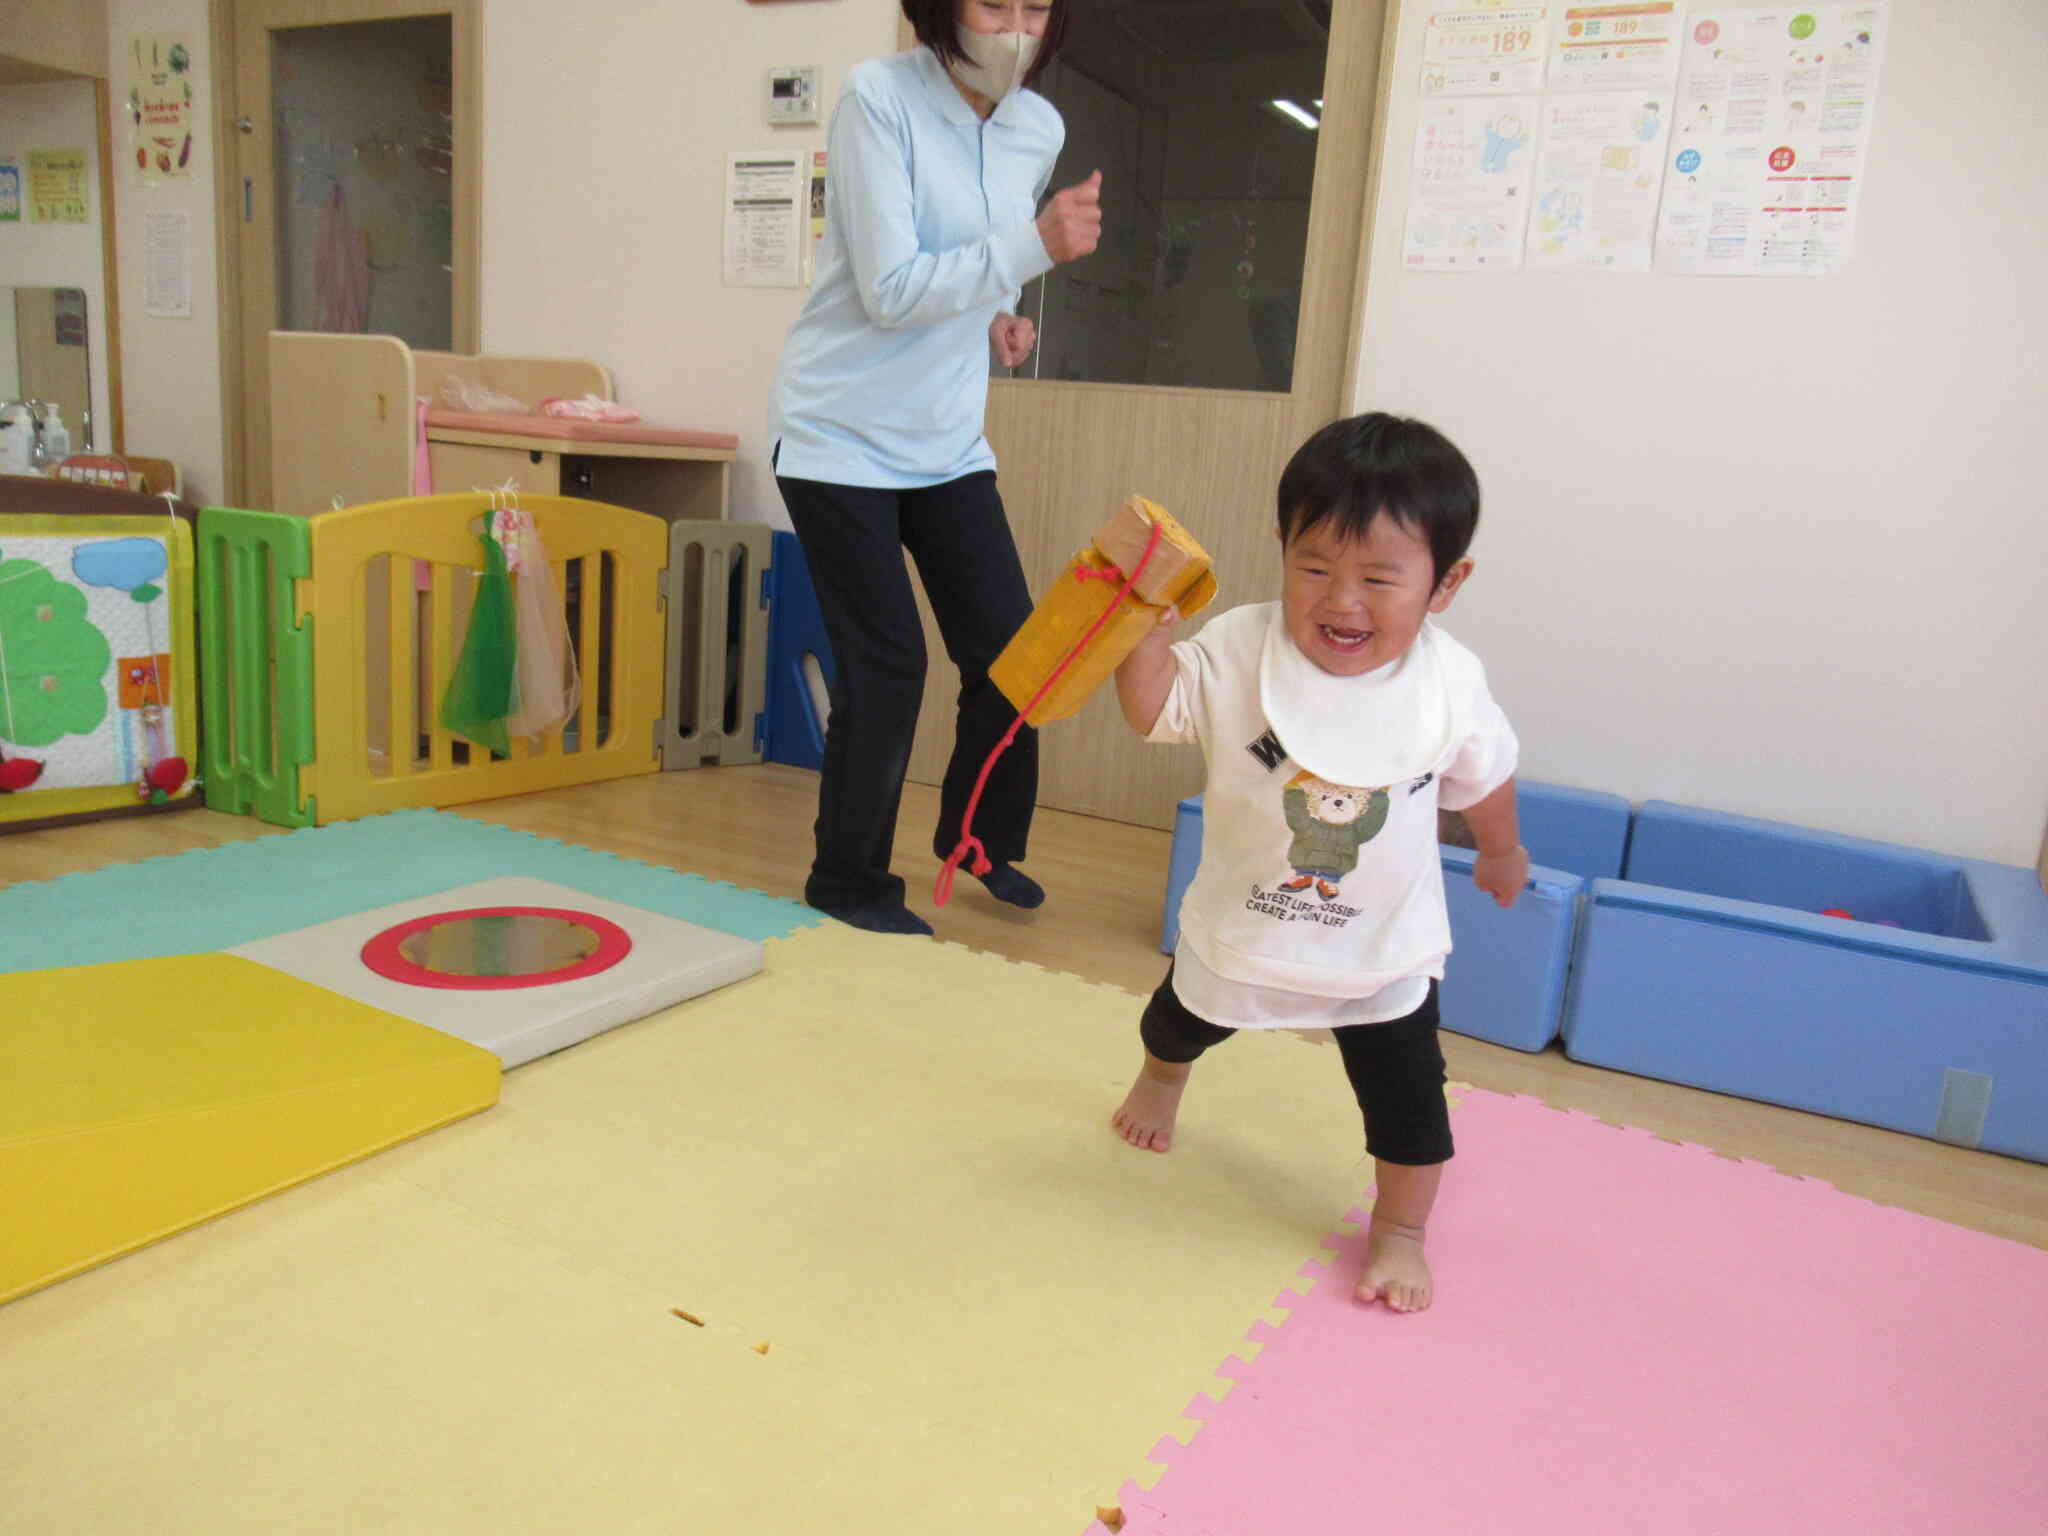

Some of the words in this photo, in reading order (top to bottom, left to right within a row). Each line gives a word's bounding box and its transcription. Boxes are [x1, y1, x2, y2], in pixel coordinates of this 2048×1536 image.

[1614, 20, 1638, 35] 189
[1492, 30, 1531, 53] 189
[1246, 900, 1287, 921] CREATE
[1298, 912, 1320, 922] UN
